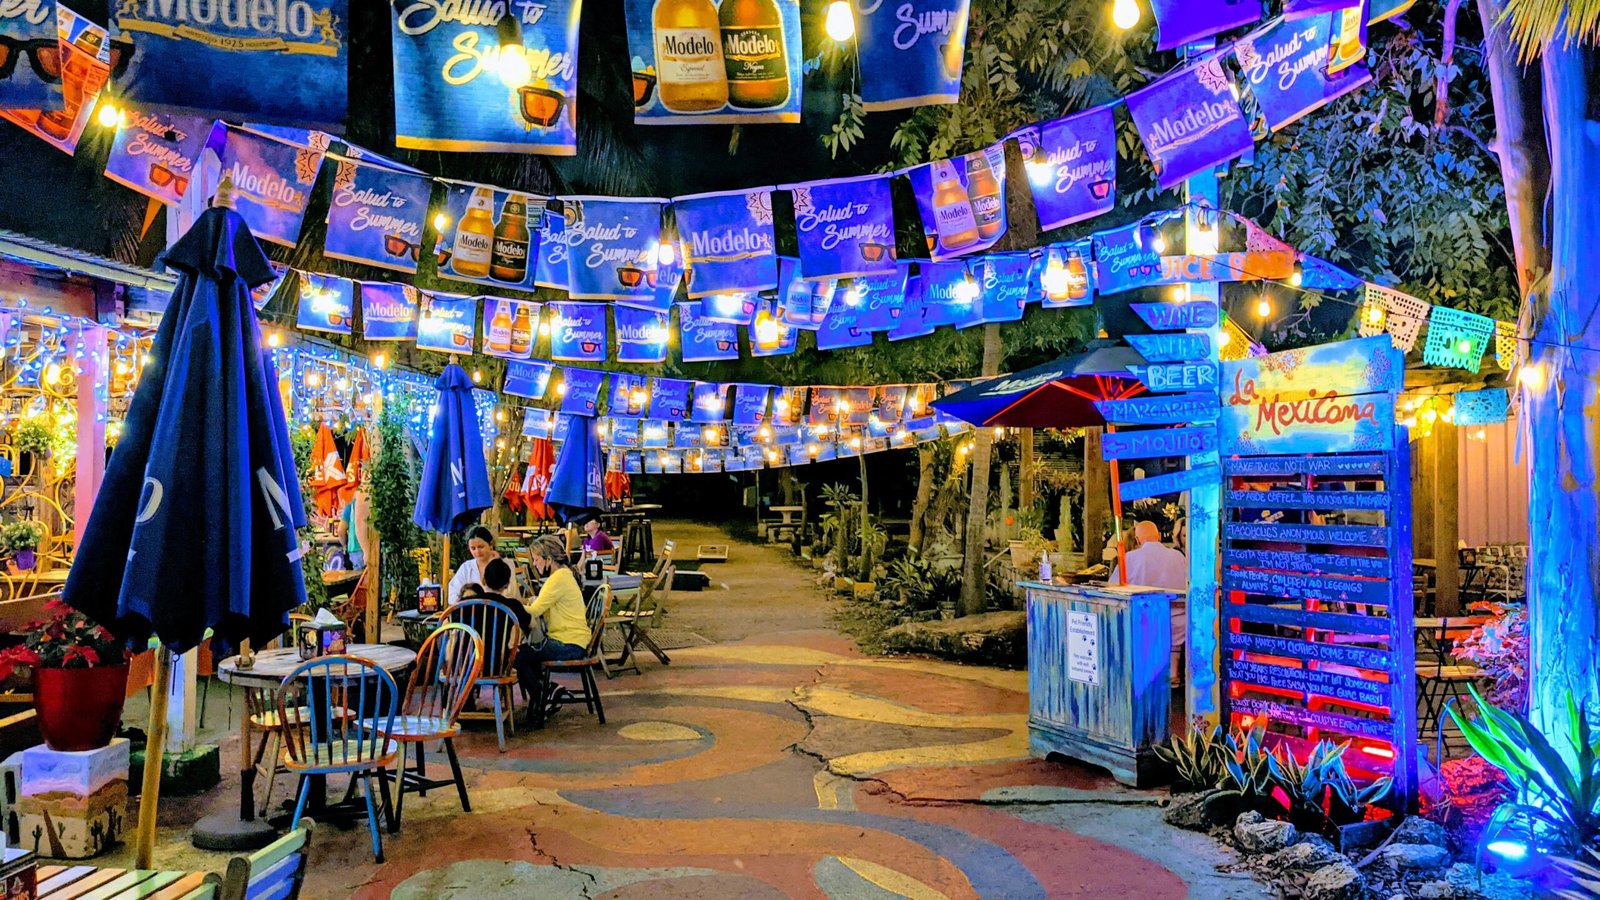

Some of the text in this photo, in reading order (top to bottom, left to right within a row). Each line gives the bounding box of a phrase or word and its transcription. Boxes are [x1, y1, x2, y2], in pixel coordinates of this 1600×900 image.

[515, 0, 546, 24] to
[665, 35, 714, 55] Modelo
[727, 34, 776, 55] Modelo
[1251, 25, 1317, 84] Salud to
[1279, 45, 1328, 91] Summ
[1153, 101, 1225, 142] Modelo
[126, 132, 192, 173] Summer
[1082, 140, 1098, 152] to
[231, 161, 295, 205] Modelo
[335, 182, 407, 209] Salud to
[350, 207, 418, 239] Summer
[800, 202, 869, 231] Salud to
[940, 204, 968, 222] Modelo
[462, 234, 489, 250] Modelo
[567, 222, 638, 247] Salud to
[692, 227, 760, 256] Modelo
[821, 220, 890, 250] Summer
[496, 240, 523, 257] Modelo
[369, 302, 410, 319] Modelo
[1148, 304, 1208, 325] WINE
[563, 326, 604, 343] Summer
[694, 327, 735, 343] Summer
[1147, 365, 1215, 388] BEER
[1229, 367, 1259, 406] La
[1255, 388, 1379, 435] Mexicana
[1132, 431, 1215, 454] MOJITOS
[1231, 459, 1331, 472] MAKE TACOS NOT WAR
[1280, 528, 1325, 541] ANONYMOUS
[1328, 530, 1368, 542] WELCOME
[1235, 550, 1257, 559] GOTTA
[1257, 552, 1269, 560] SEE
[1335, 557, 1350, 567] GET
[1323, 580, 1363, 592] LEGGINGS
[1287, 641, 1318, 656] CLOTHES
[1320, 647, 1344, 660] COME
[1233, 661, 1249, 670] NEW
[1344, 677, 1379, 693] SOMEONE
[1271, 676, 1286, 688] FREE
[1336, 687, 1357, 700] GUAC
[1359, 690, 1383, 705] BABY!
